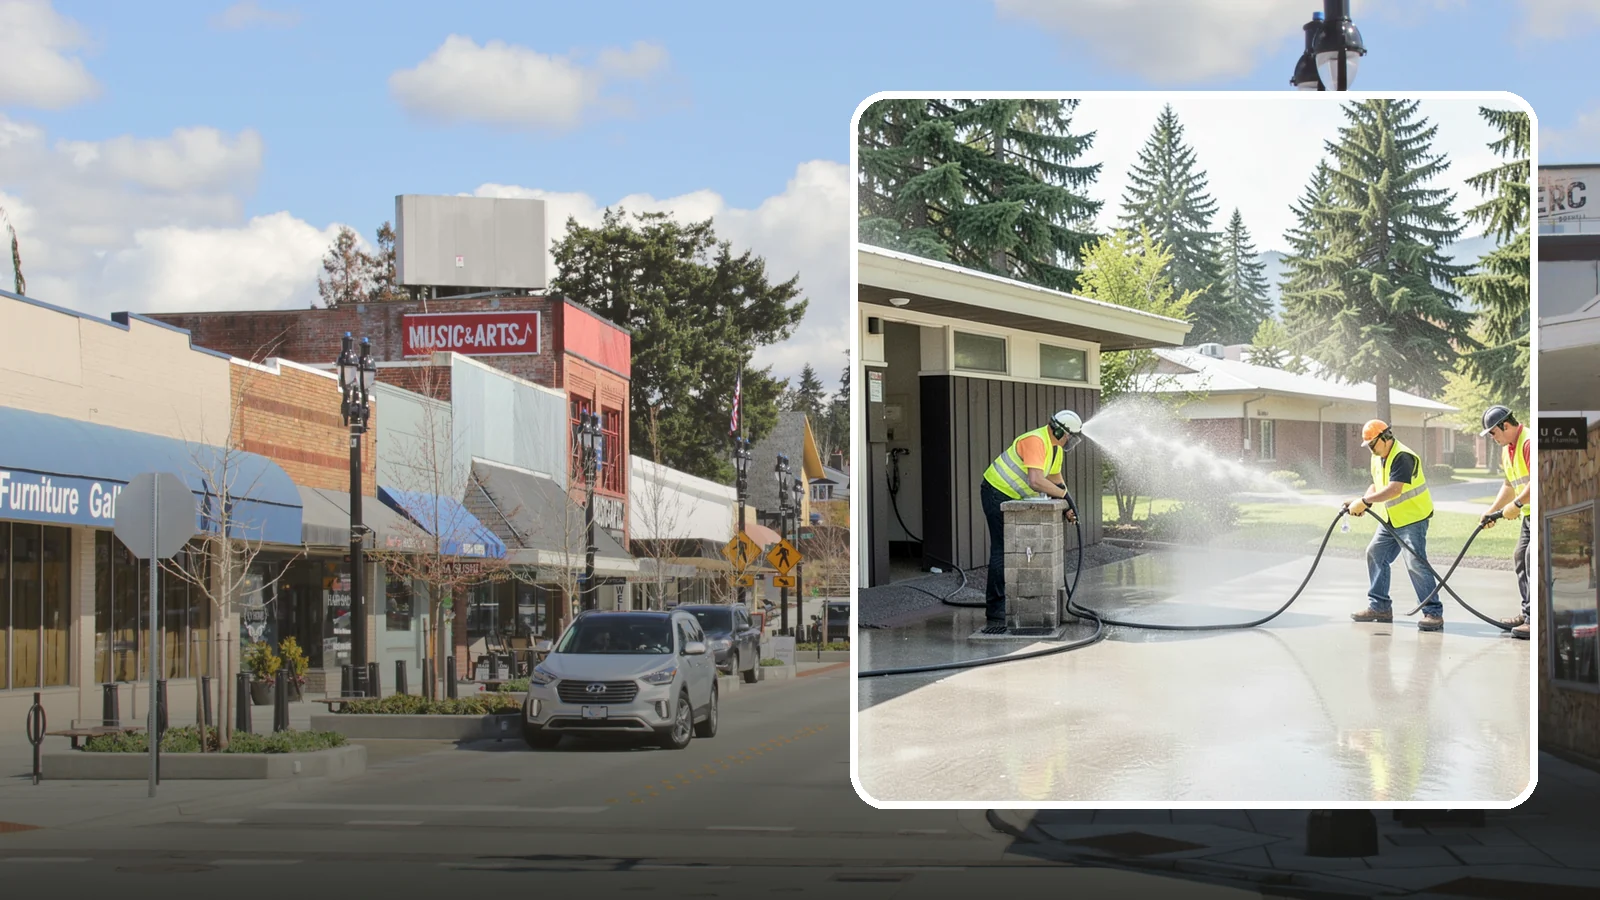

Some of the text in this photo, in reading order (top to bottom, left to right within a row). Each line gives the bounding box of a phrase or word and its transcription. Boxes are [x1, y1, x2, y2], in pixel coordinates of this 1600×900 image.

[408, 323, 520, 349] MUSIC&ARTS
[0, 471, 122, 519] Furniture Gal
[453, 563, 479, 574] SUSHI
